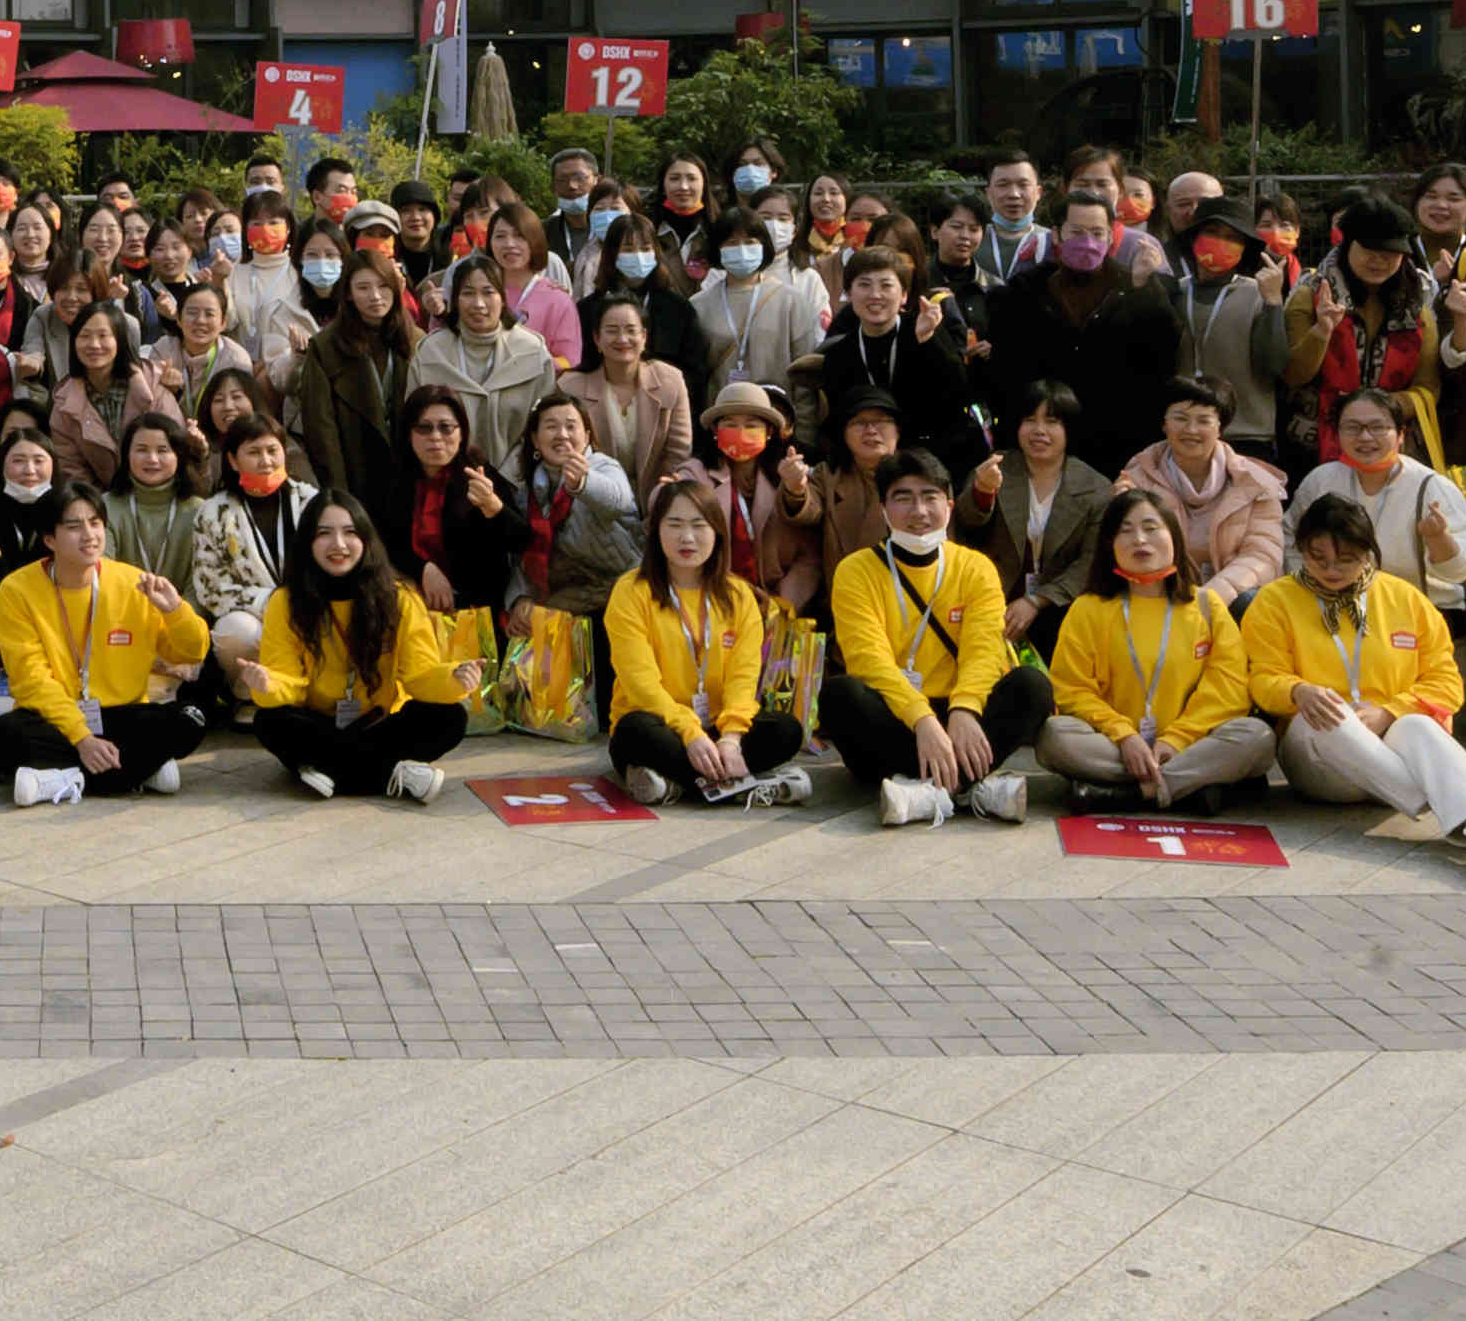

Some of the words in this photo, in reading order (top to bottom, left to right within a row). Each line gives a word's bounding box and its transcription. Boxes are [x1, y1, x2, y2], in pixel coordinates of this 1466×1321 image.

[434, 0, 446, 35] 8
[601, 44, 630, 59] DSHX
[590, 66, 644, 107] 12
[288, 89, 313, 126] 4
[1146, 836, 1187, 856] 1
